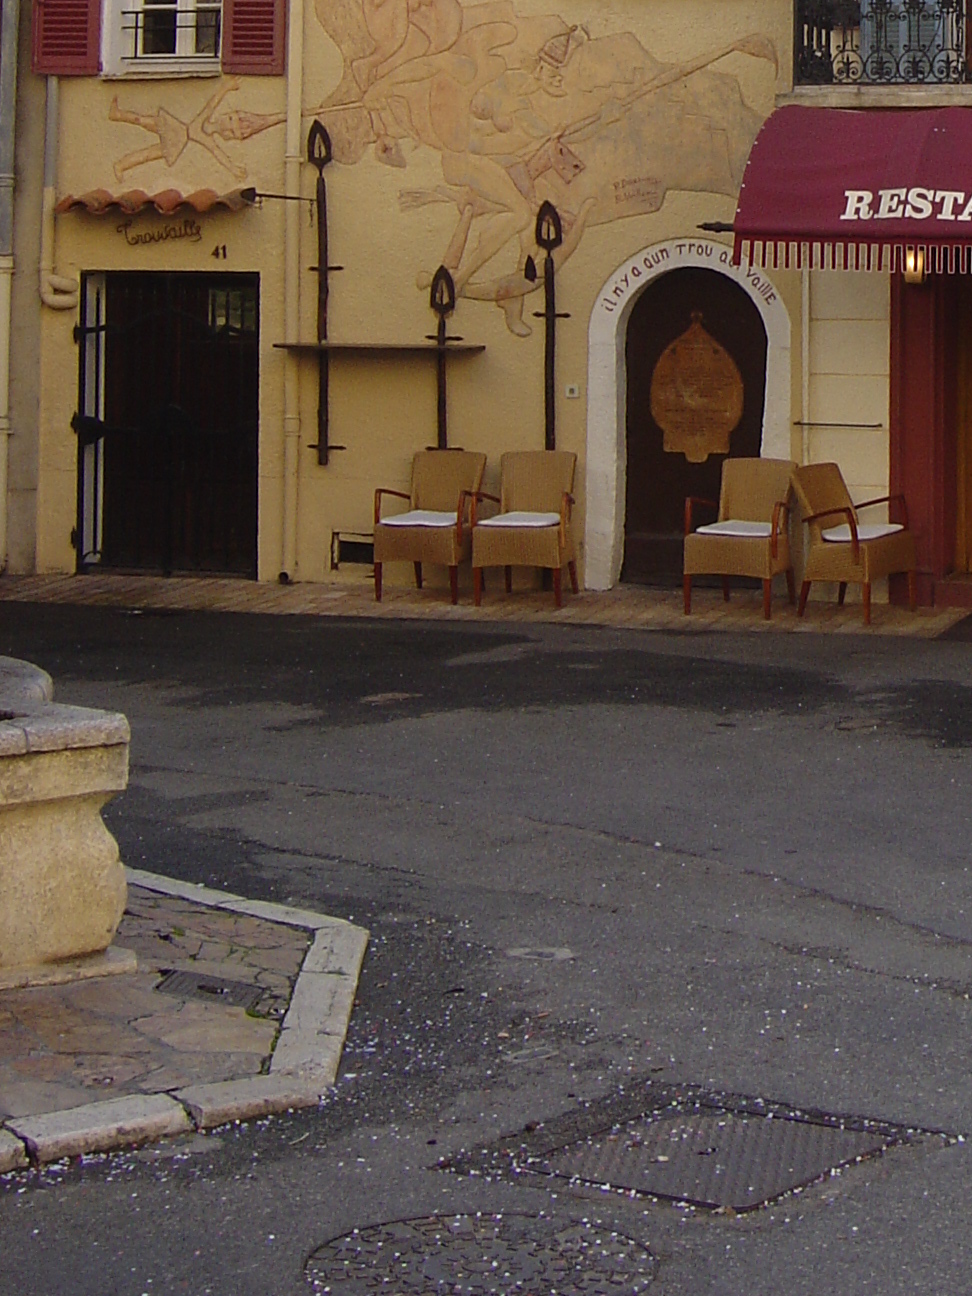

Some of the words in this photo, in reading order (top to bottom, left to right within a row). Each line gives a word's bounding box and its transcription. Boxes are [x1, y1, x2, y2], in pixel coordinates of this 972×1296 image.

[116, 219, 202, 246] Trouvaille
[211, 244, 228, 260] 41
[601, 297, 618, 312] il
